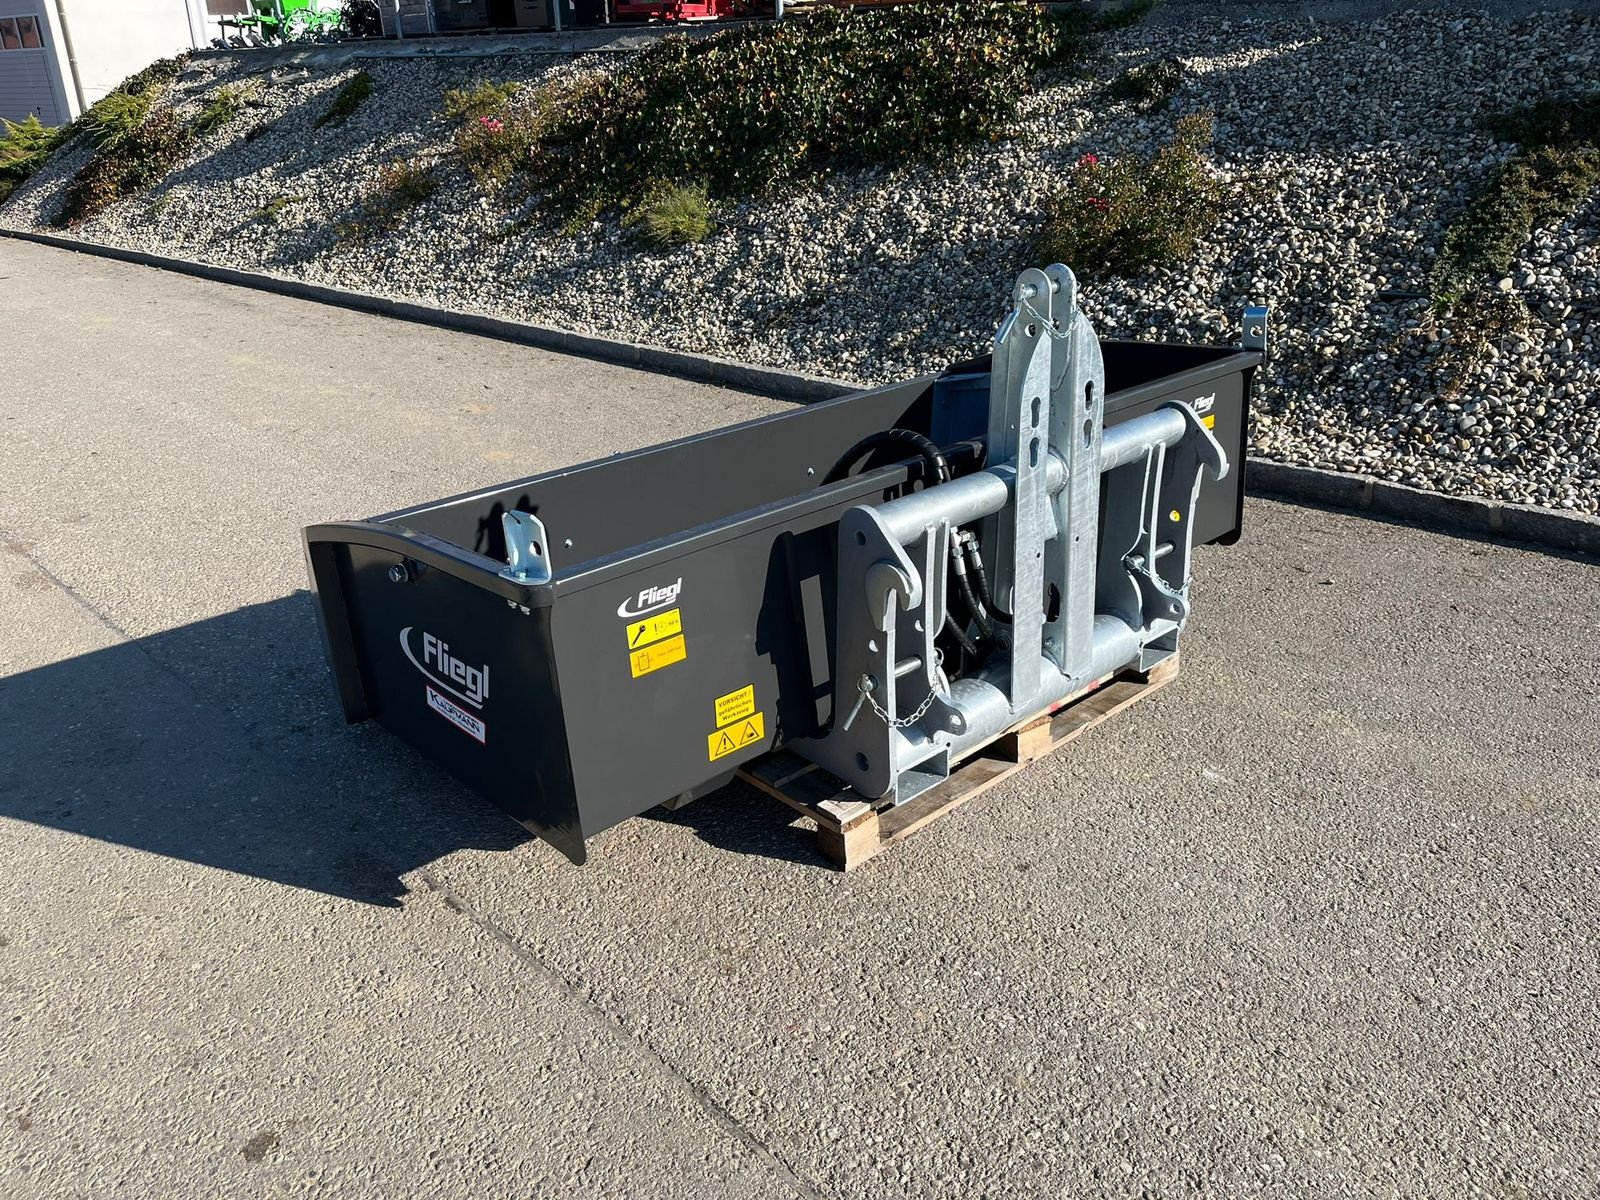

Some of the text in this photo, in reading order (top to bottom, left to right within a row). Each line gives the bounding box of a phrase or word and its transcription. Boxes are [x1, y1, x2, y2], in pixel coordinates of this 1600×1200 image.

[1193, 392, 1216, 410] Fliegl
[637, 576, 683, 608] Fliegl
[422, 631, 490, 703] Fliegl
[718, 690, 748, 708] VORSICHT
